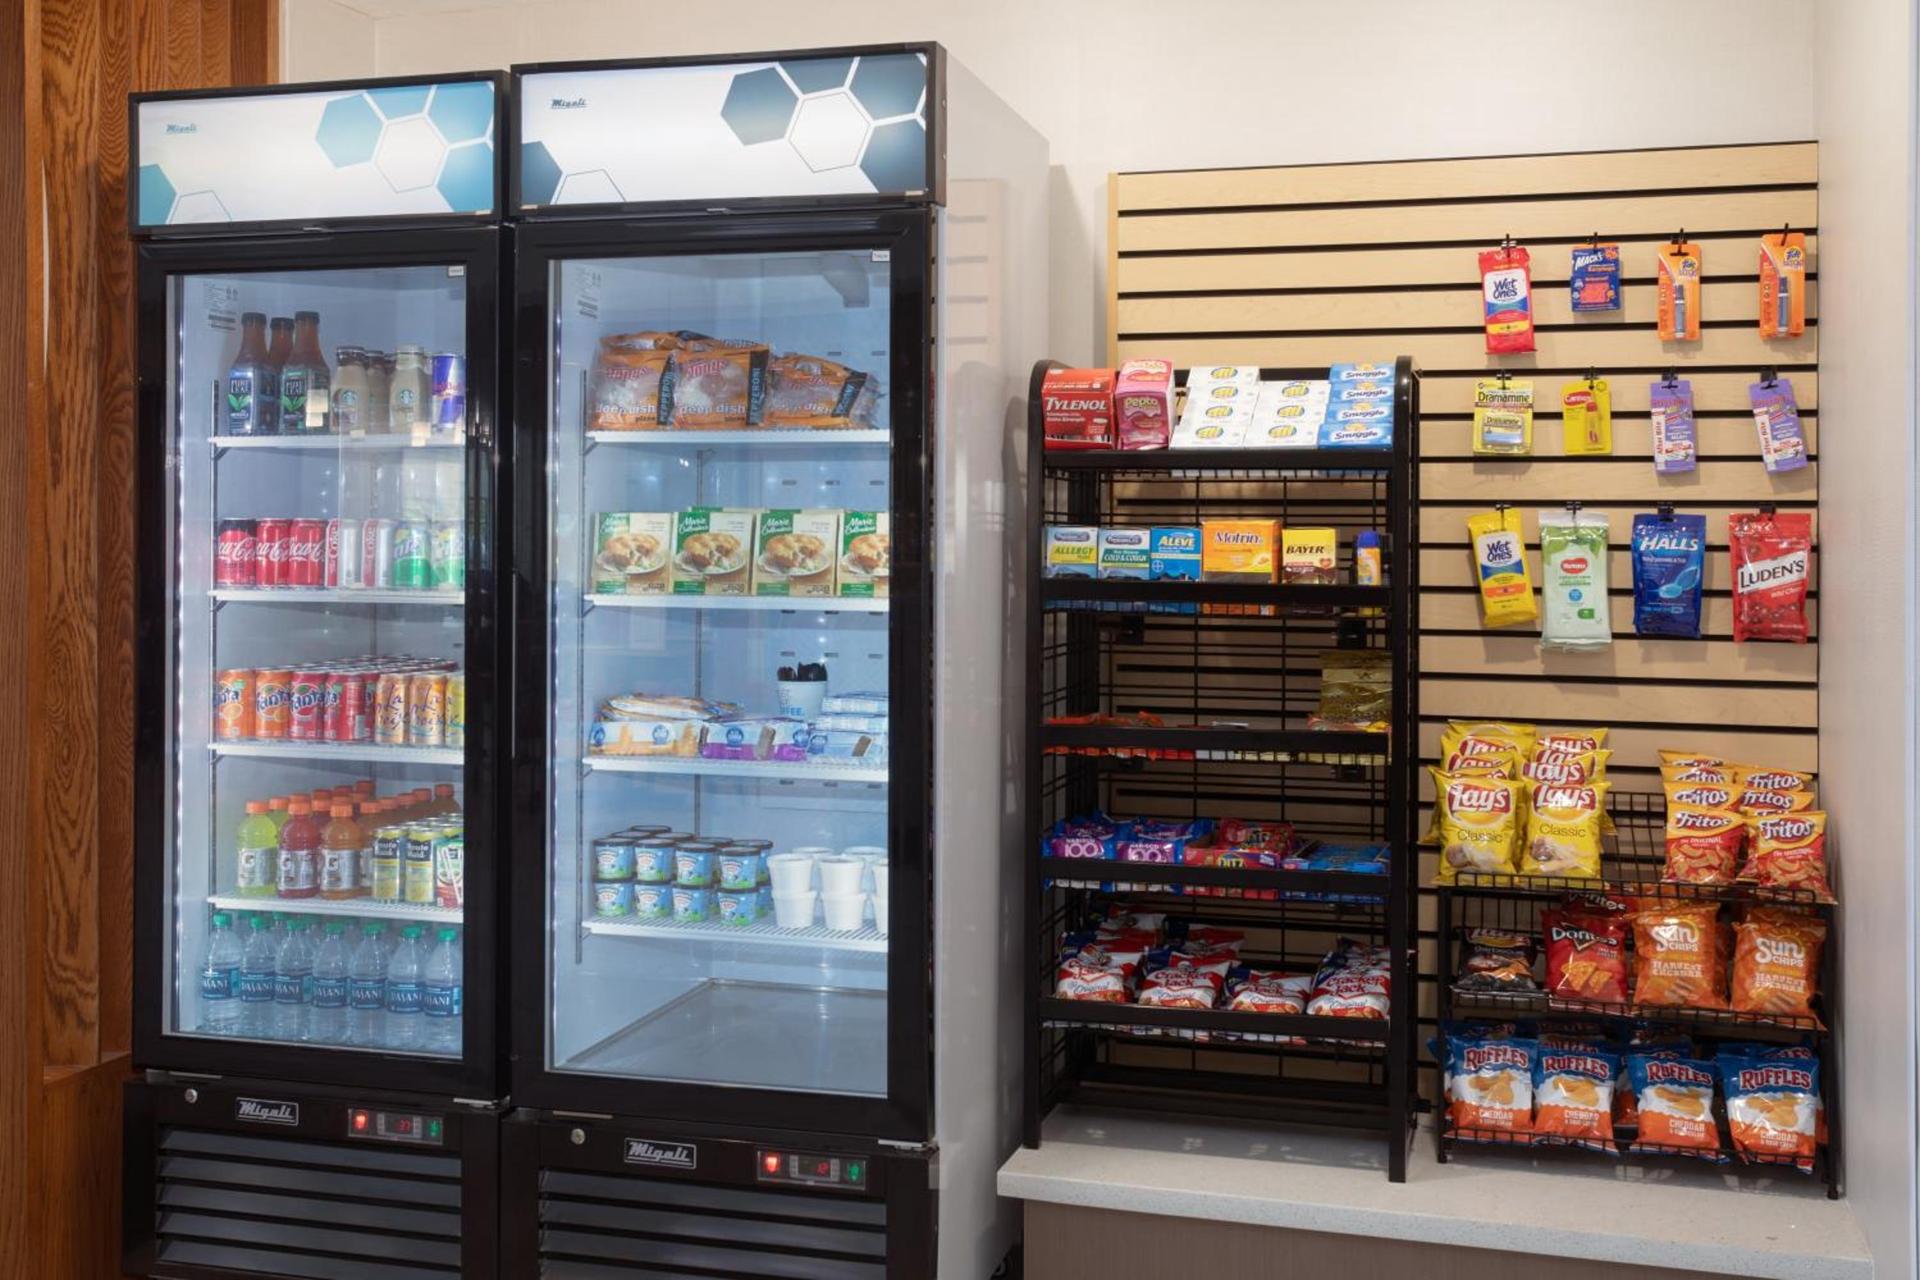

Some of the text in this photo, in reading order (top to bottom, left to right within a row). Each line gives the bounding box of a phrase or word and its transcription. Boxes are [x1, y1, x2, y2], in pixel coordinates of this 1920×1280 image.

[1493, 278, 1518, 289] Wet
[1493, 288, 1518, 299] Ones
[1044, 397, 1107, 411] TYLENOL
[1478, 391, 1530, 403] Dramamine
[1158, 536, 1195, 547] ALEVE
[1215, 532, 1259, 545] Motrin
[1639, 536, 1698, 551] HALLS
[1286, 545, 1324, 554] BAYER
[1487, 541, 1512, 553] Wet
[1487, 551, 1512, 562] Ones
[1741, 560, 1805, 588] LUDEN'S
[1743, 790, 1792, 808] Fritos
[1676, 812, 1734, 830] Fritos
[1457, 829, 1503, 843] Classic
[1539, 824, 1586, 838] Classic
[1759, 818, 1814, 840] Fritos
[1551, 927, 1618, 945] Dors
[1651, 925, 1699, 952] Sun
[1668, 941, 1699, 952] CHIPS
[1755, 937, 1806, 964] Sun
[1772, 955, 1805, 967] CHIPS
[1335, 984, 1366, 993] Jack
[1464, 1046, 1529, 1069] RUFFLES
[1543, 1055, 1610, 1079] RUFFLES
[1646, 1061, 1713, 1085] RUFFLES
[1739, 1067, 1812, 1090] RUFFLES
[238, 1101, 293, 1119] Migali
[628, 1142, 691, 1162] Migali
